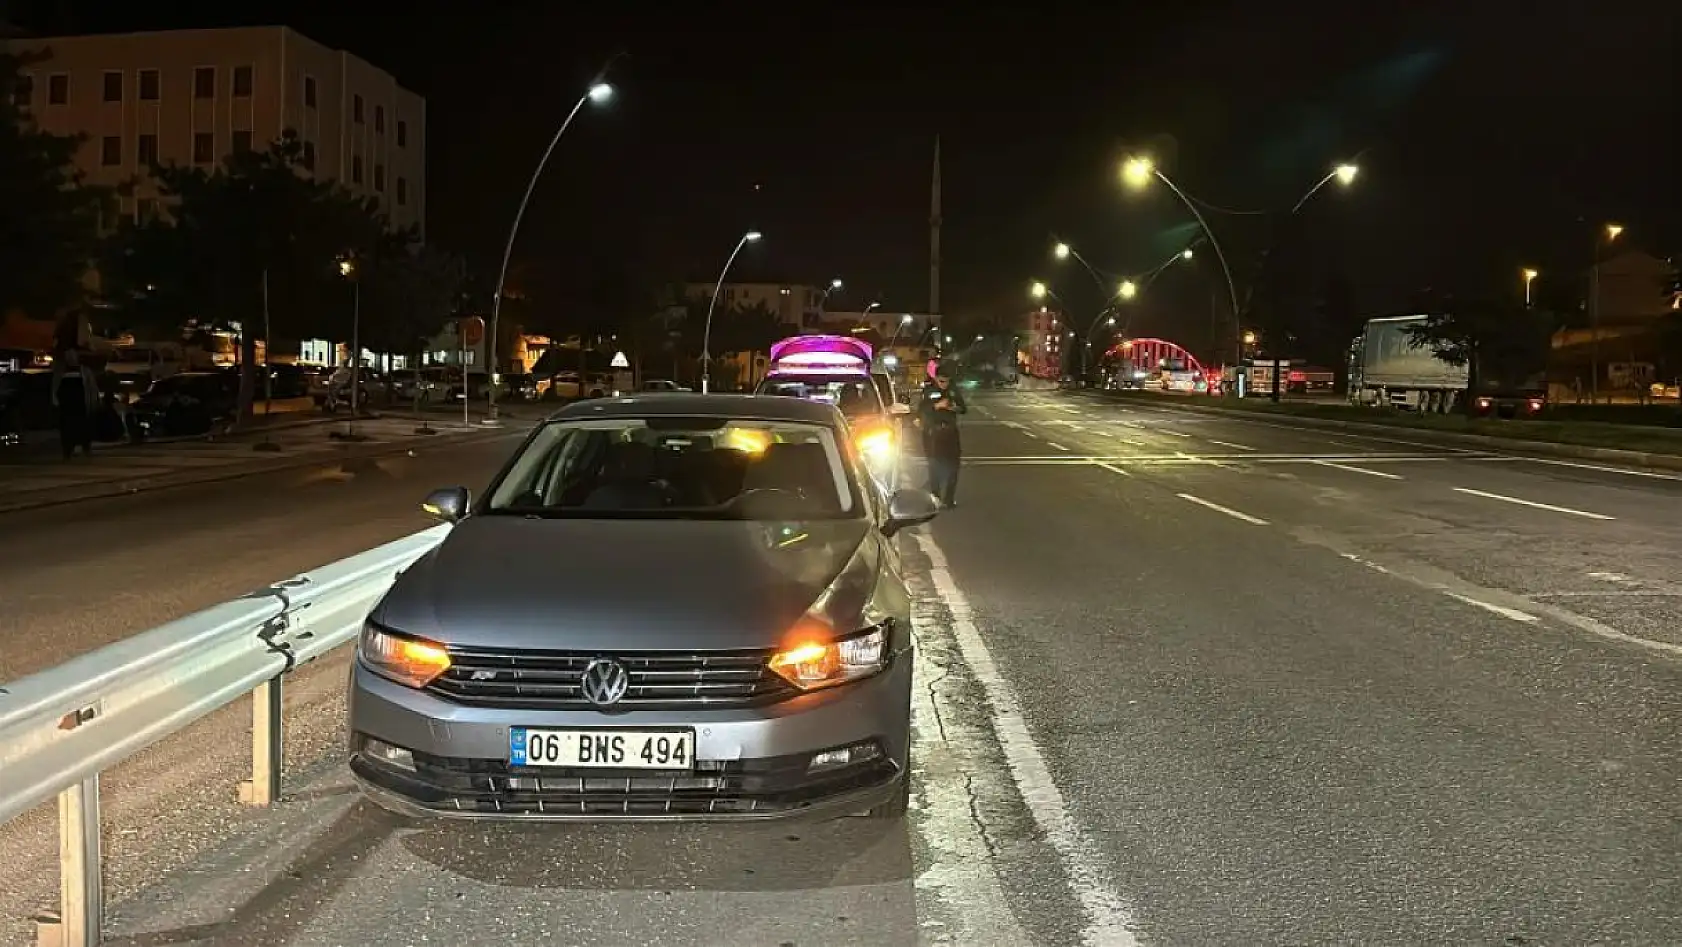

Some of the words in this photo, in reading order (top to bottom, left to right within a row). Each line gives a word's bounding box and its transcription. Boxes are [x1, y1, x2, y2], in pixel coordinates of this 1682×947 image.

[529, 734, 559, 762] 06
[578, 734, 625, 763] BNS
[640, 736, 686, 765] 494
